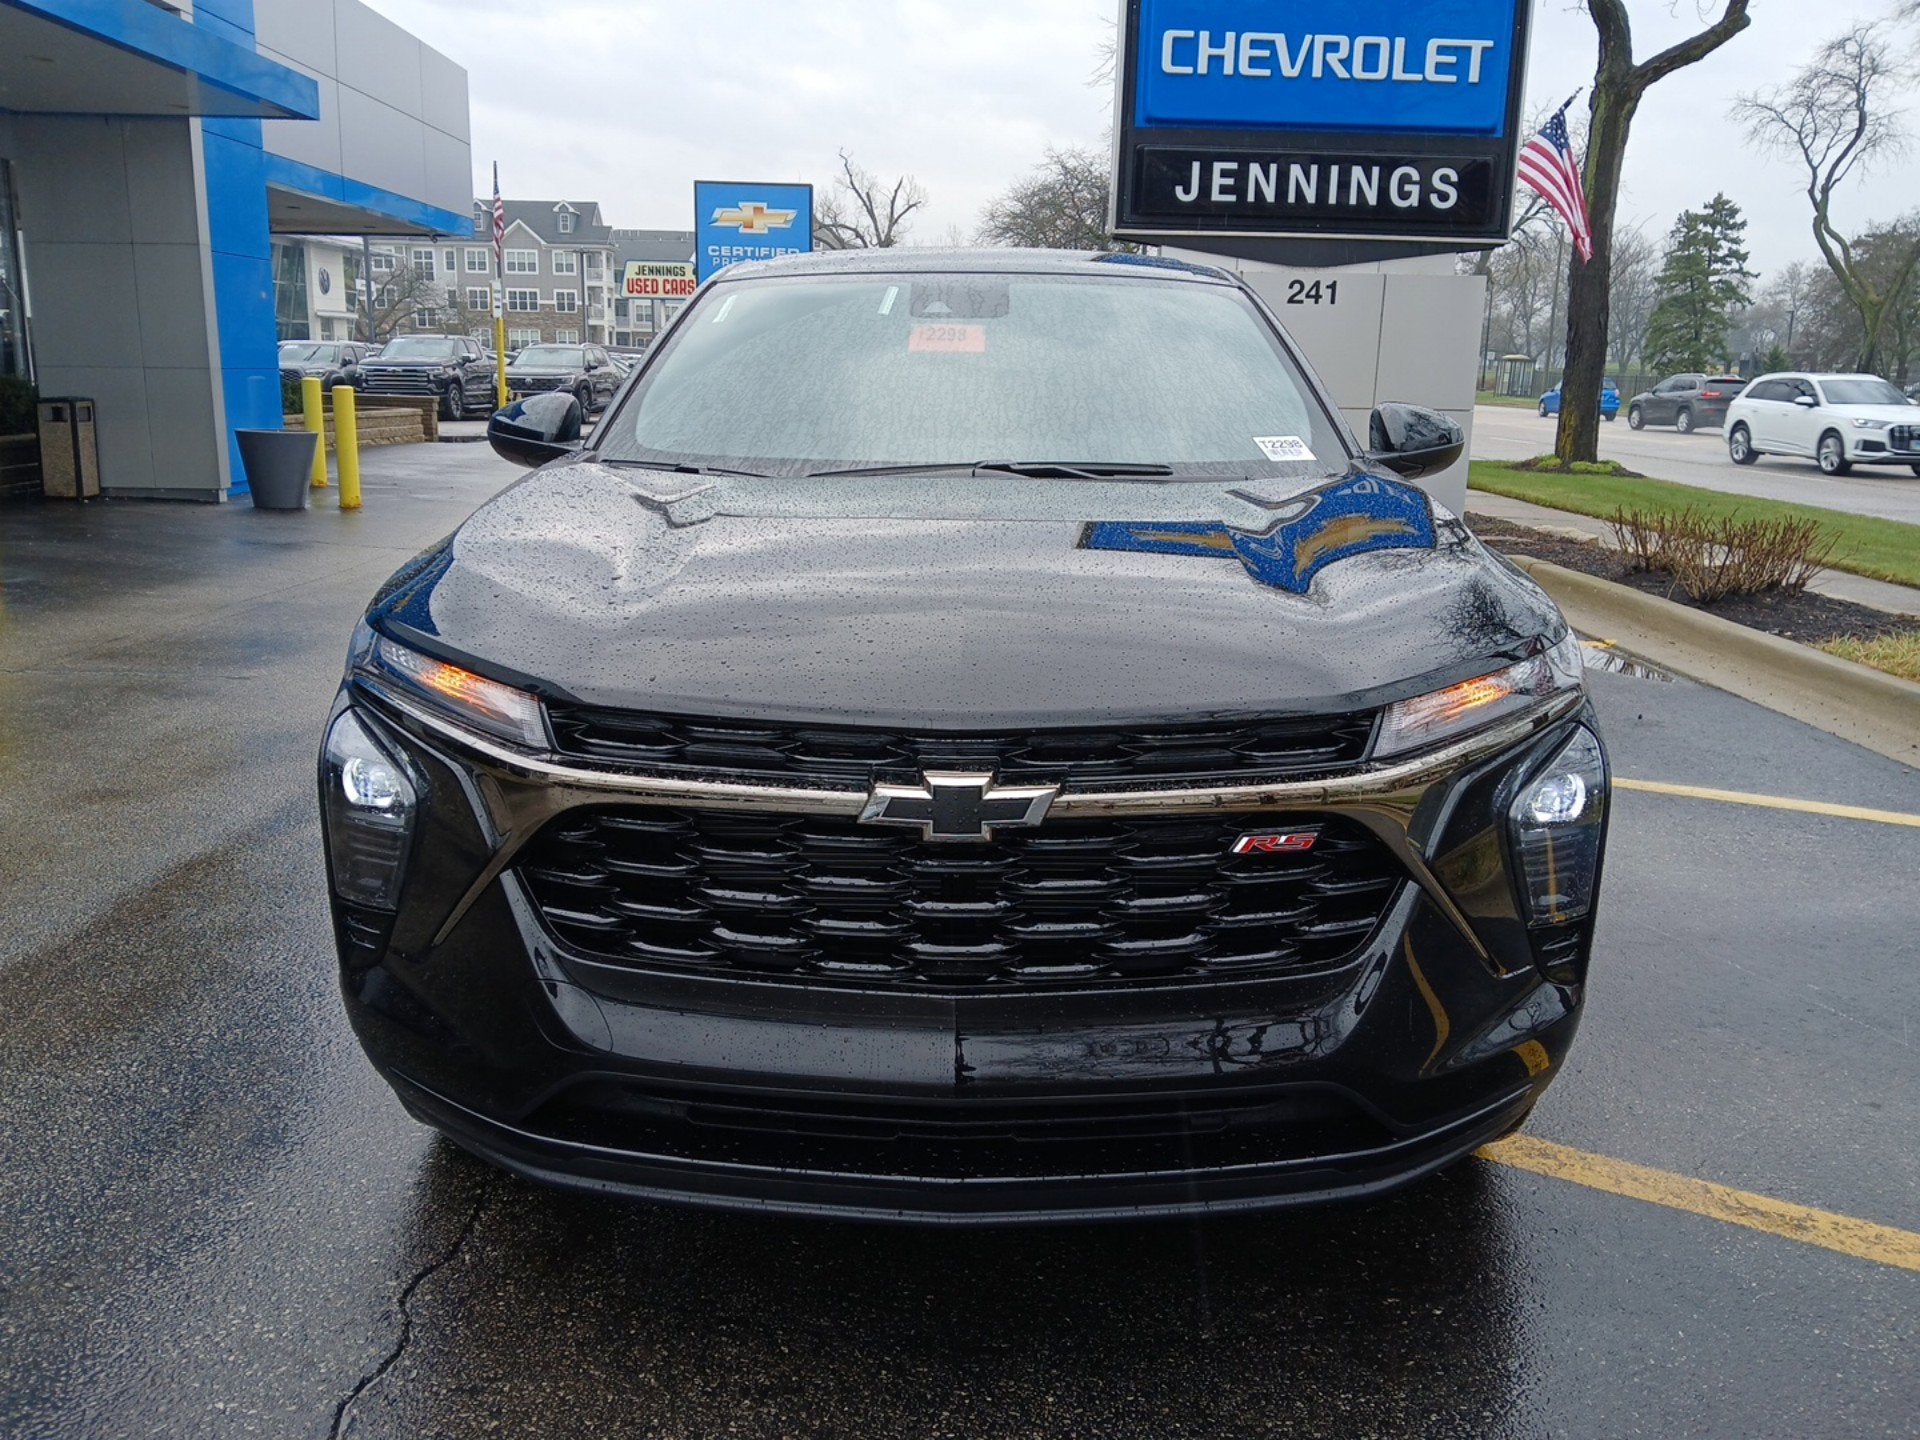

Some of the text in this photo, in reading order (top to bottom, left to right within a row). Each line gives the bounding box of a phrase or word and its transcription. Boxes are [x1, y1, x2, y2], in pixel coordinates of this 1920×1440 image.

[1161, 29, 1494, 83] CHEVROLET
[1175, 160, 1459, 209] JENNINGS
[635, 265, 686, 277] JENNINGS
[627, 277, 696, 295] USED CARS
[1287, 279, 1338, 305] 241
[1230, 832, 1318, 854] RS
